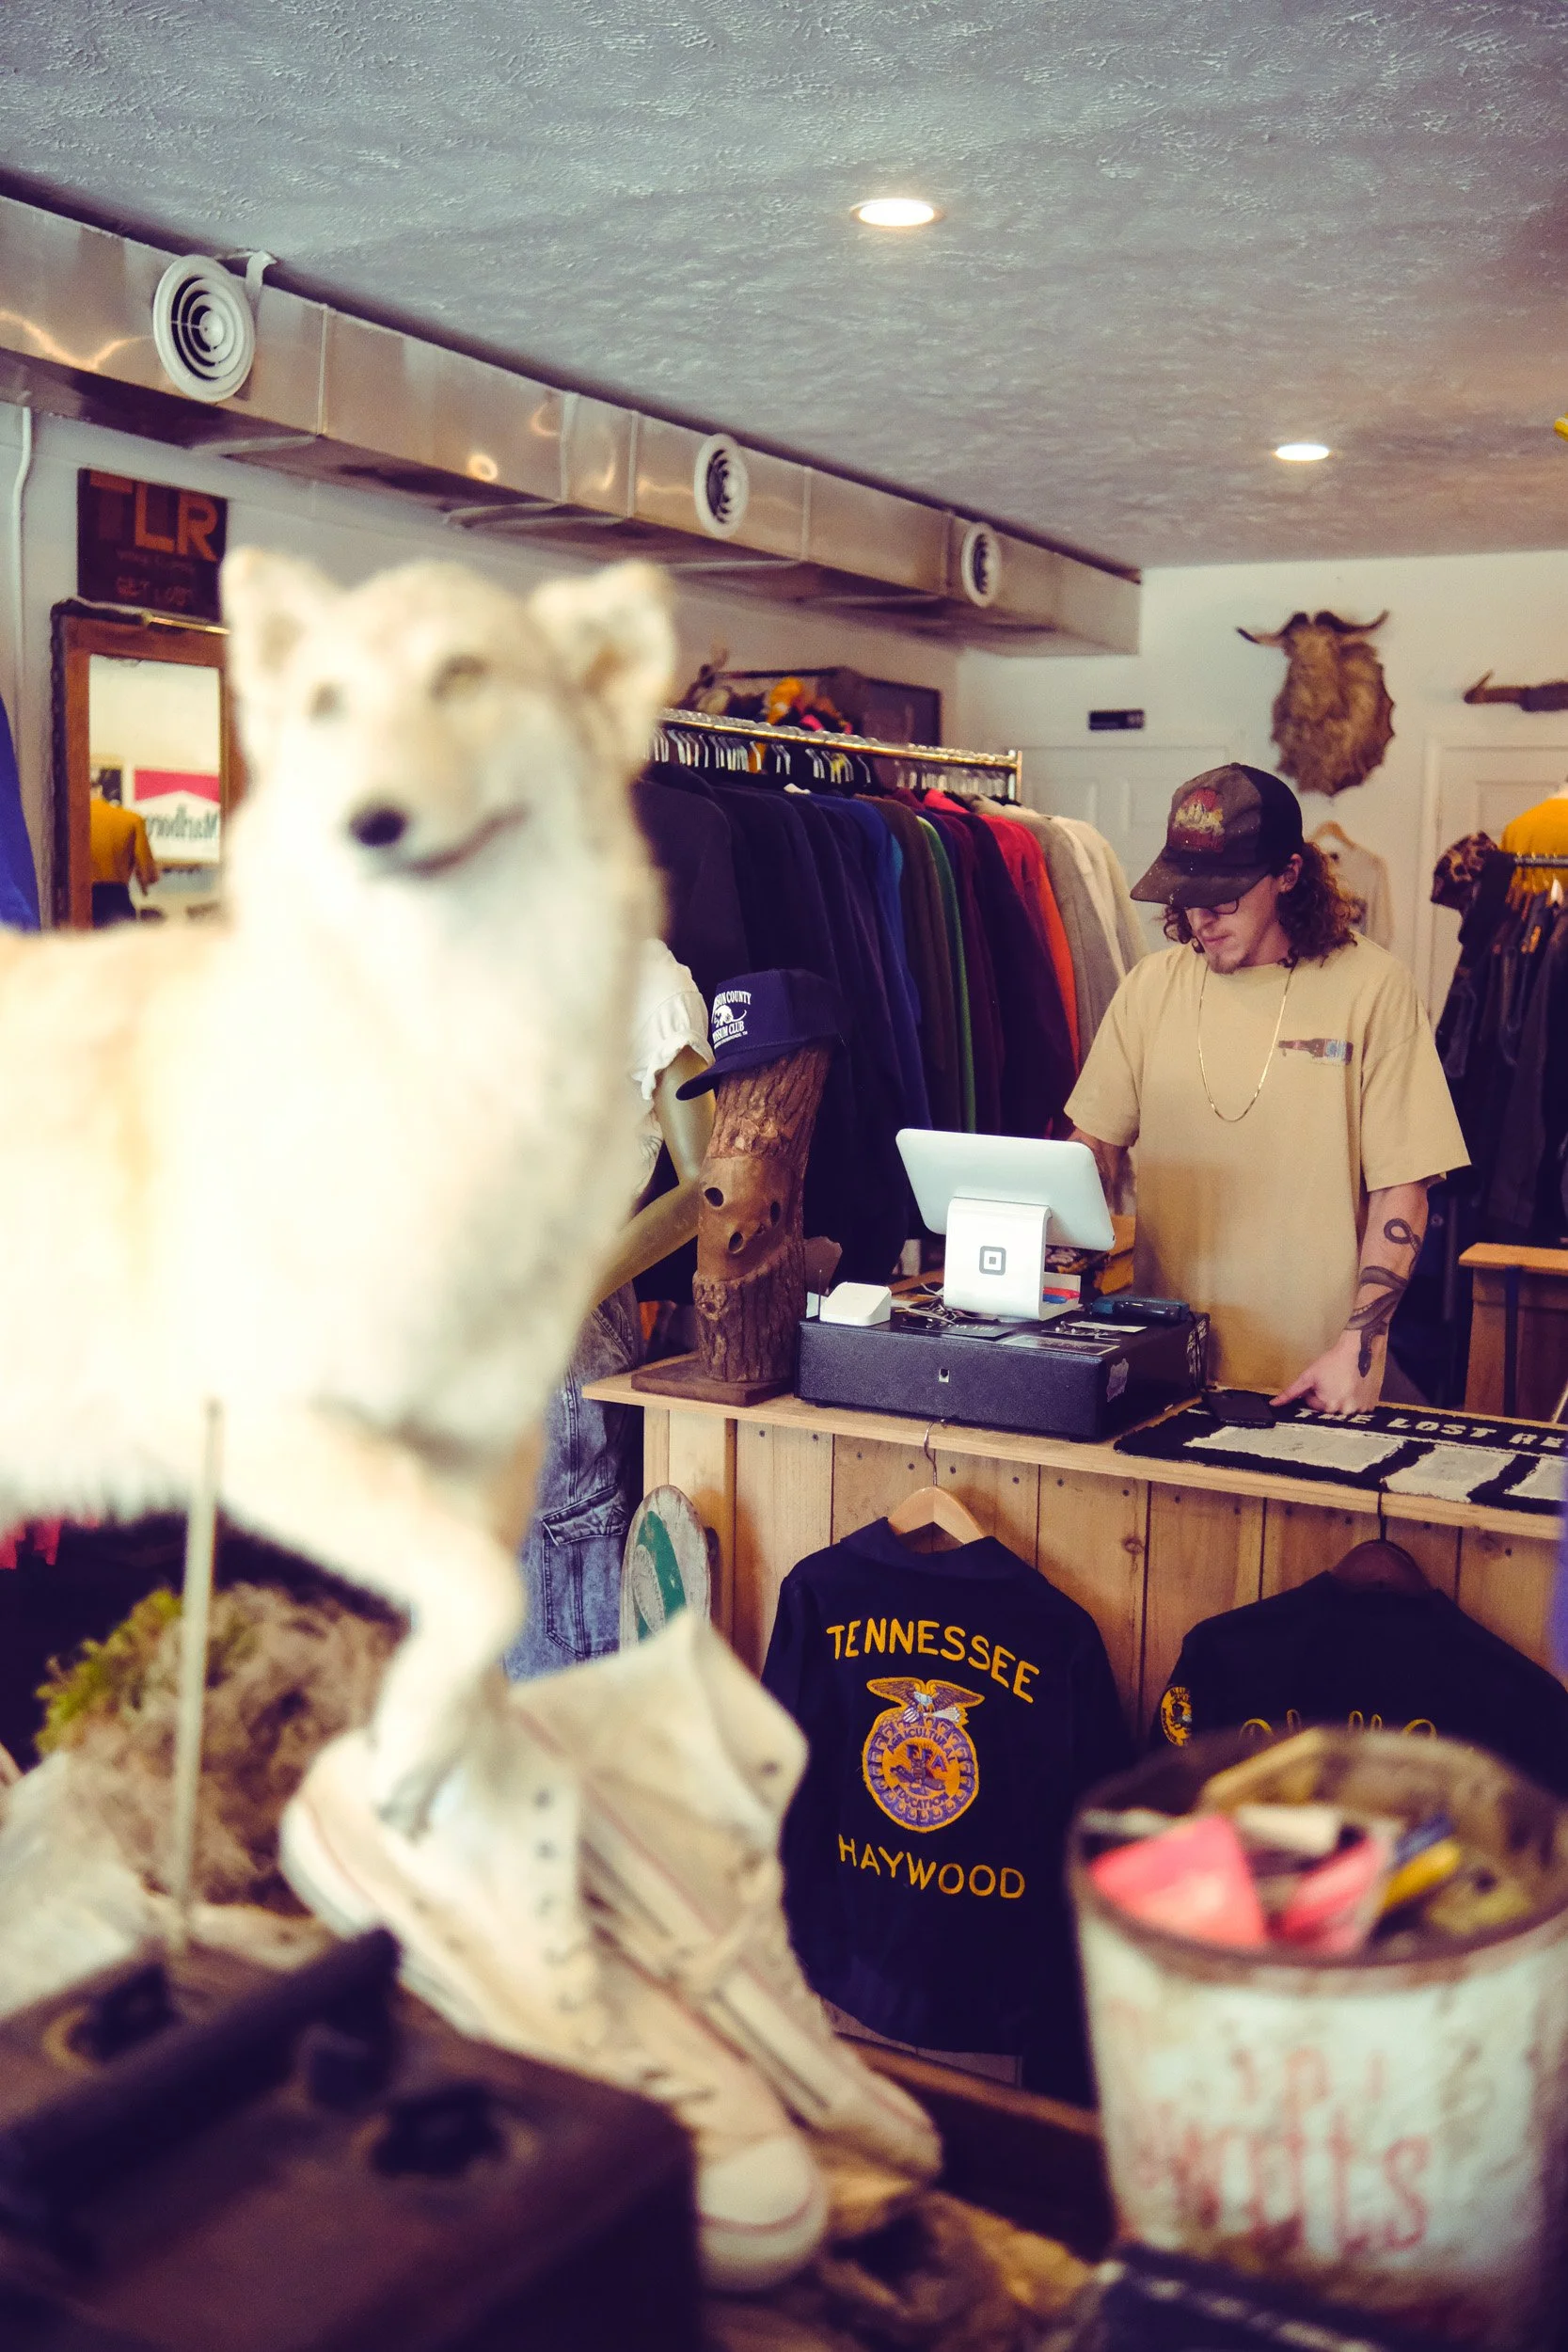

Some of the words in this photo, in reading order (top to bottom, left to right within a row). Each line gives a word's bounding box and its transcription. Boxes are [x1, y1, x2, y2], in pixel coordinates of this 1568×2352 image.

[89, 470, 218, 563] TLR
[726, 991, 752, 1005] COUNTY
[729, 1021, 745, 1034] CLUB
[1294, 1407, 1374, 1426] THE
[1386, 1417, 1497, 1438] LOST
[1508, 1432, 1568, 1449] RE
[826, 1617, 1040, 1704] TENNESSEE
[887, 1727, 956, 1764] AGRICULTURAL
[907, 1743, 948, 1772] FFA
[894, 1785, 950, 1809] EDUCATION
[837, 1834, 1026, 1899] HAYWOOD
